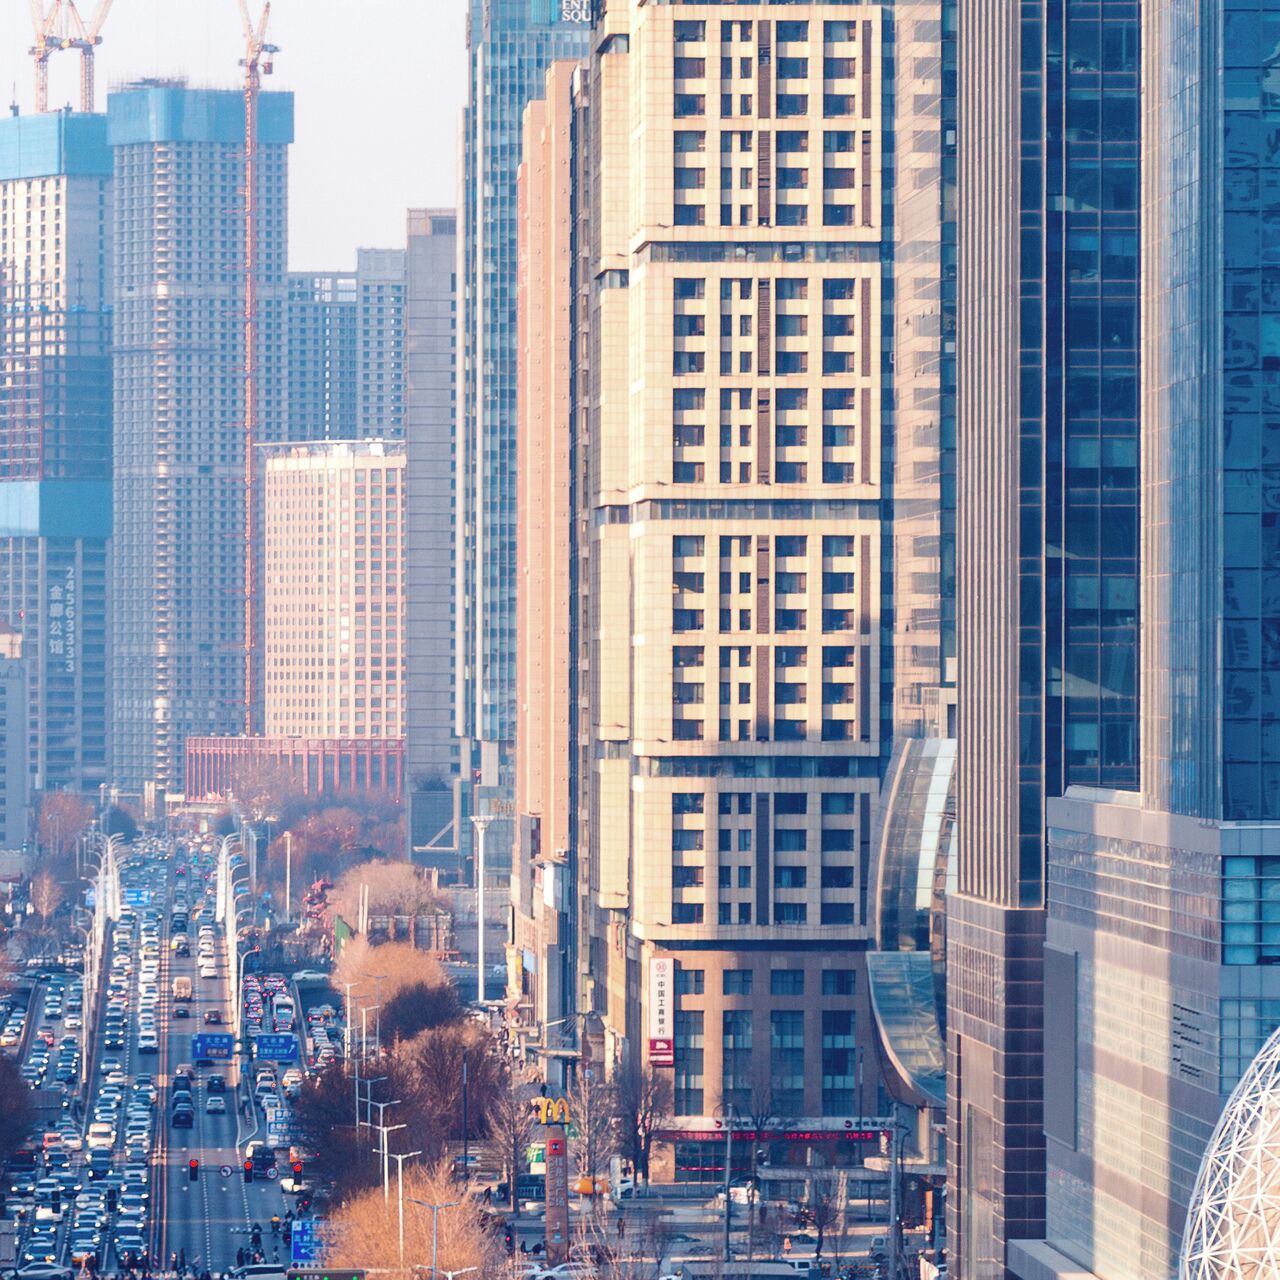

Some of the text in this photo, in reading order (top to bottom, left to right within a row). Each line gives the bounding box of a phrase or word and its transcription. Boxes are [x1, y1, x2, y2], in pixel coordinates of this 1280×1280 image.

[65, 566, 75, 673] 24563333
[657, 981, 666, 1035] 中国工商银行
